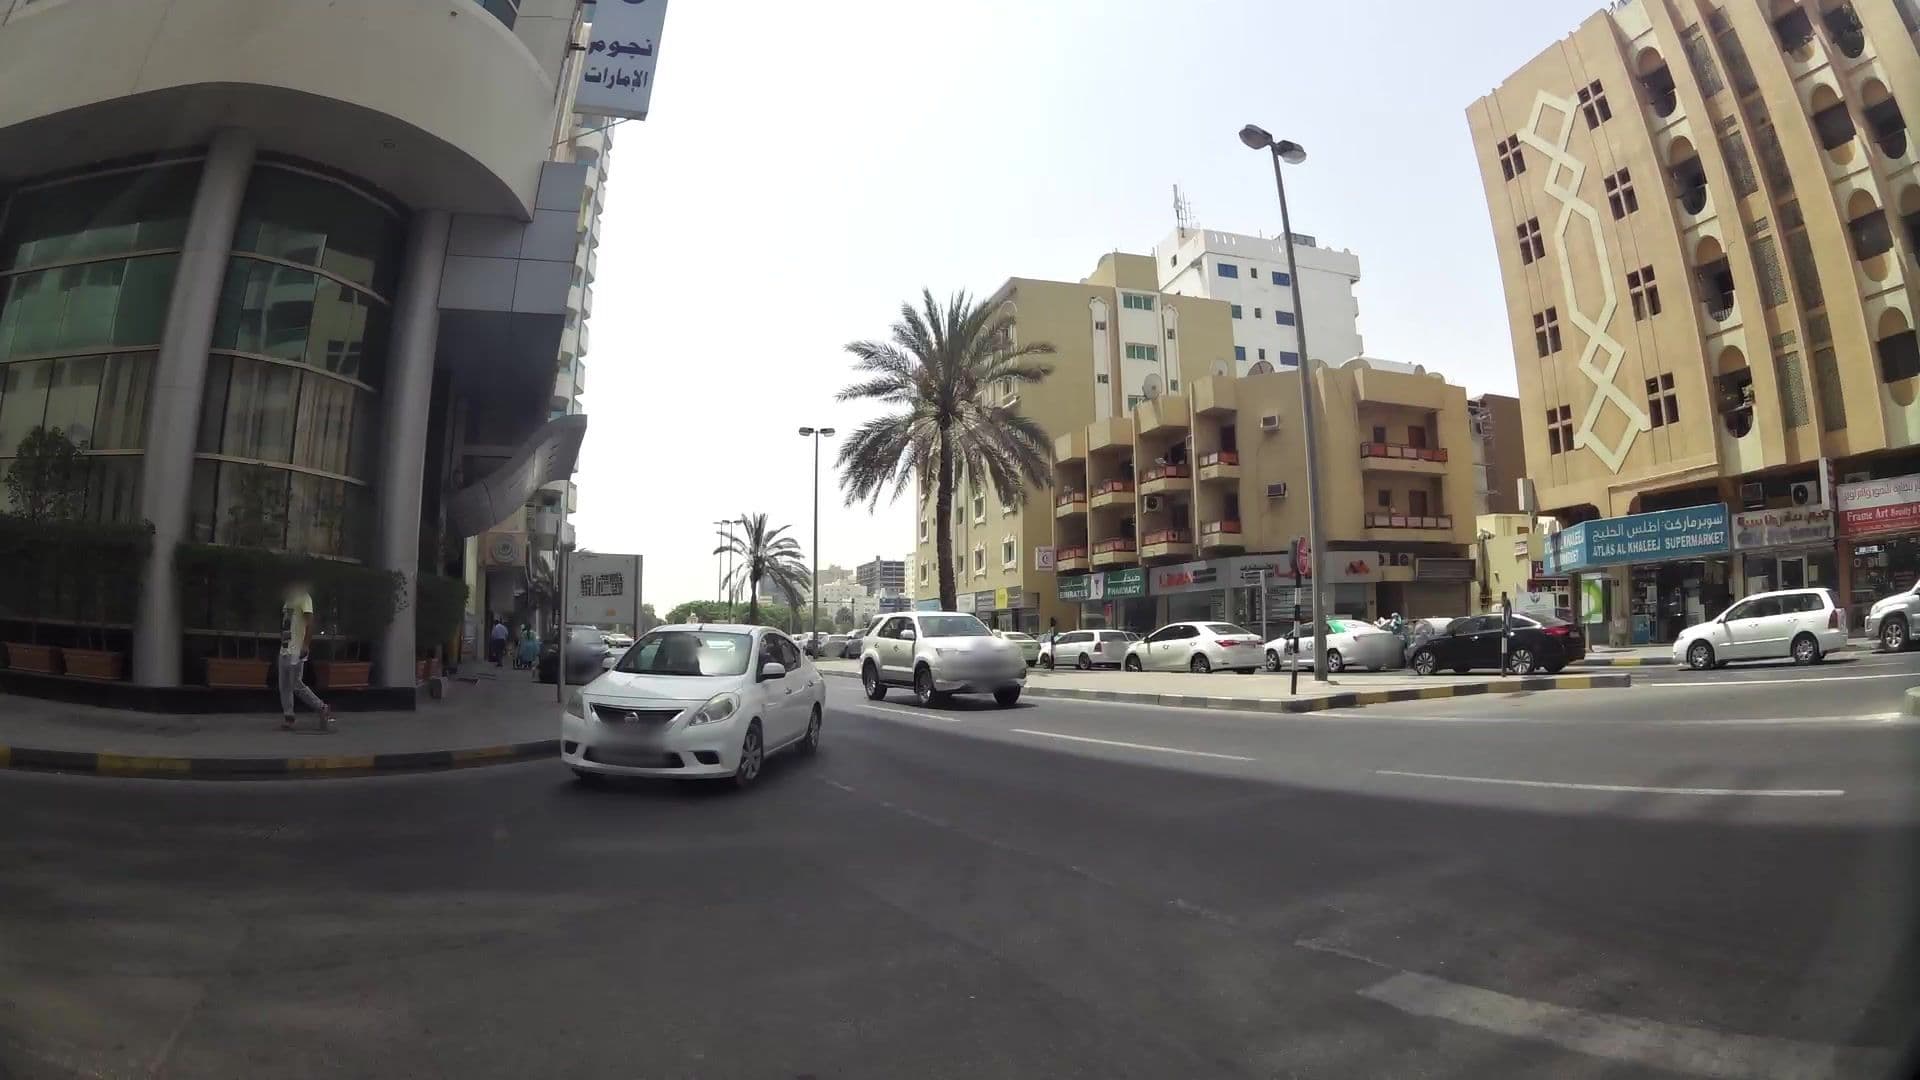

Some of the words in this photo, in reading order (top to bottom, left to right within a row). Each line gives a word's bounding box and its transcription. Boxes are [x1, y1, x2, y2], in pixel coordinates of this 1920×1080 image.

[588, 39, 652, 58] نجوم
[584, 67, 648, 92] الإمارات
[1847, 511, 1873, 522] Frame
[1875, 508, 1889, 519] Art
[1592, 543, 1615, 557] ATLAS
[1617, 543, 1626, 555] AL
[1627, 539, 1661, 553] KHALEEJ
[1664, 531, 1725, 550] SUPERMARKET
[1060, 589, 1089, 599] EMIRATES
[1107, 585, 1141, 596] PHARMACY
